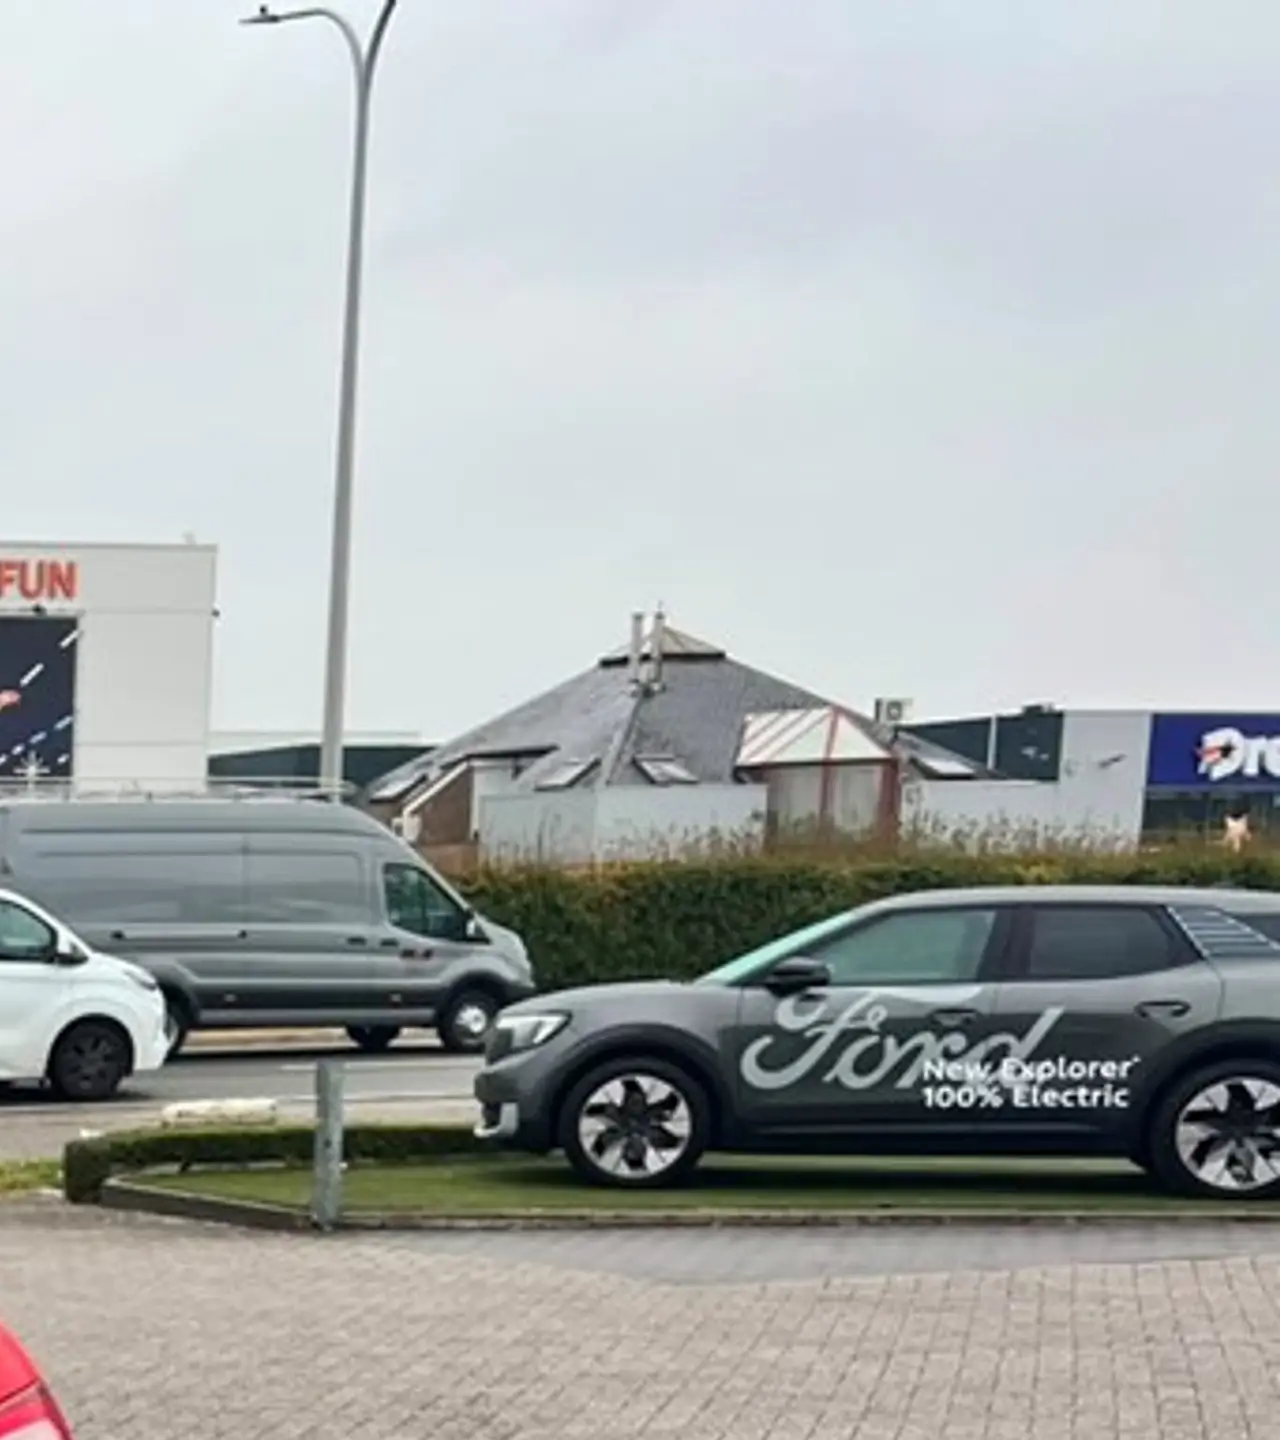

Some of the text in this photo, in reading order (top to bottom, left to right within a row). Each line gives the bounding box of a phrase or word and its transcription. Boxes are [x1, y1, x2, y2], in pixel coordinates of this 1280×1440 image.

[740, 983, 1065, 1090] Ford
[922, 1055, 1132, 1084] New Explorer
[922, 1082, 1130, 1109] 100% Electric
